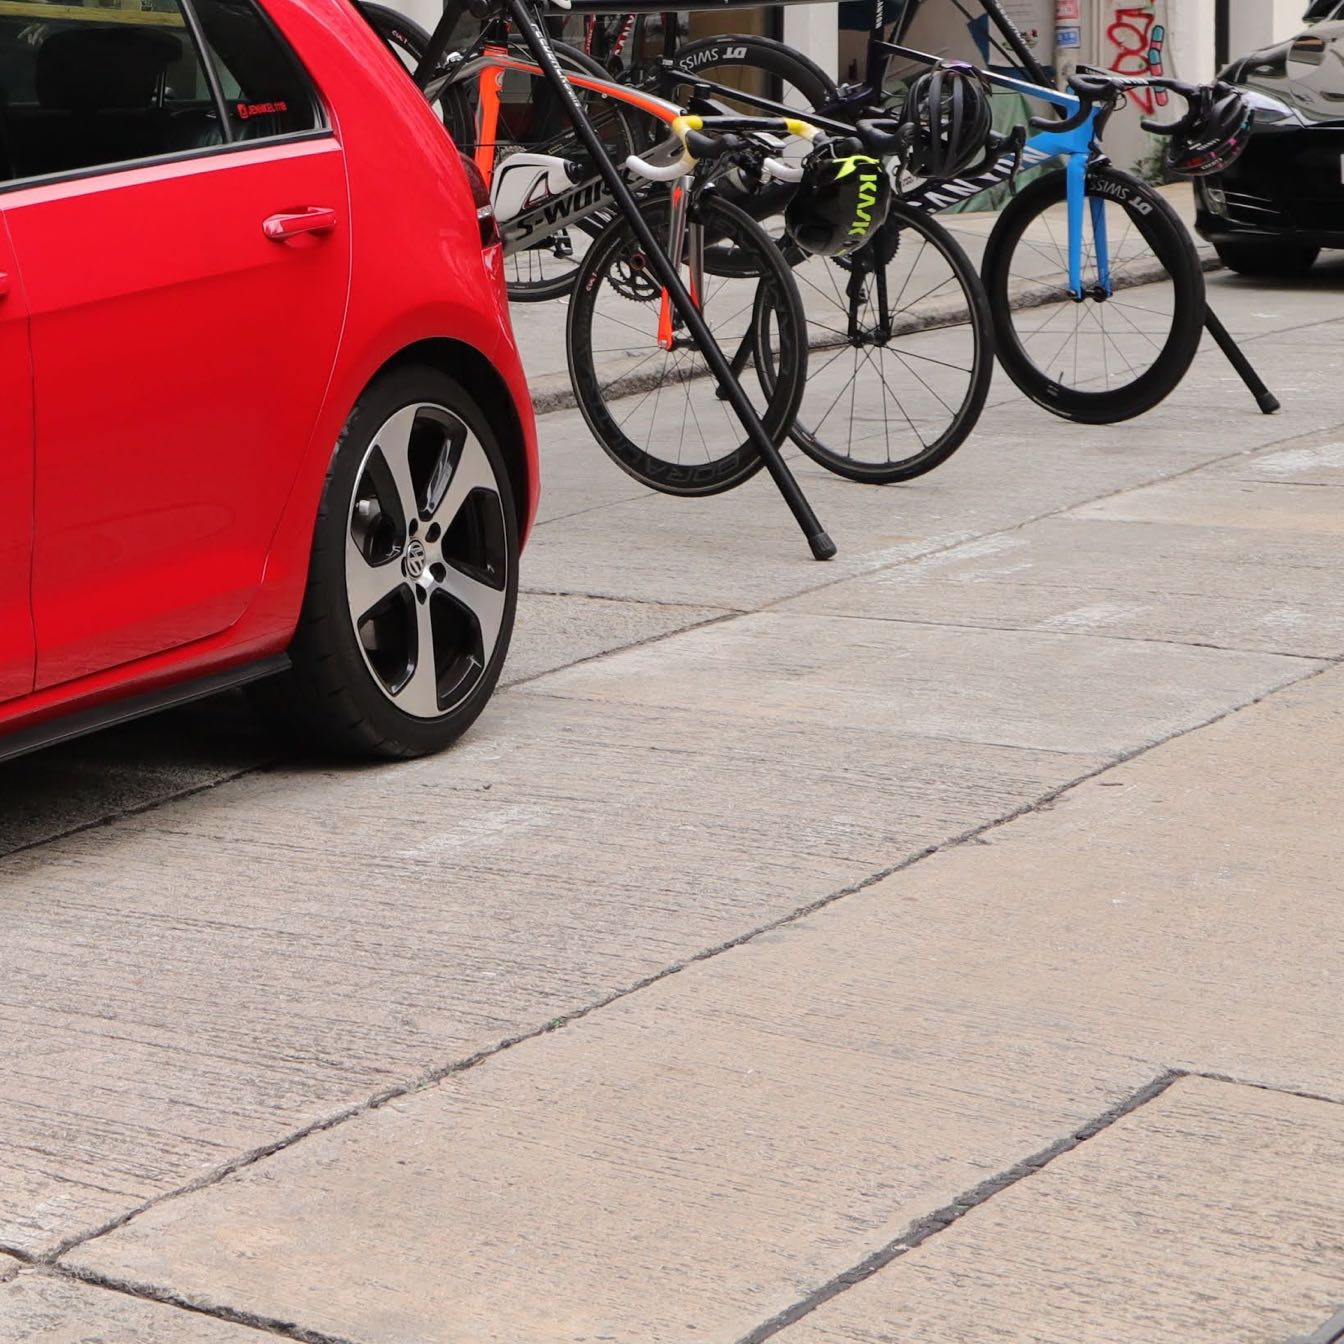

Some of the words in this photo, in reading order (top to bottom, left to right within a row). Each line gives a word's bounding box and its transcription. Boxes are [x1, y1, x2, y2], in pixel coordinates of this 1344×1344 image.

[679, 48, 719, 71] SWISS
[722, 46, 748, 59] DT
[1089, 179, 1130, 200] SWISS
[515, 180, 604, 242] S-WO
[847, 174, 878, 235] KASK
[1128, 196, 1154, 216] DT
